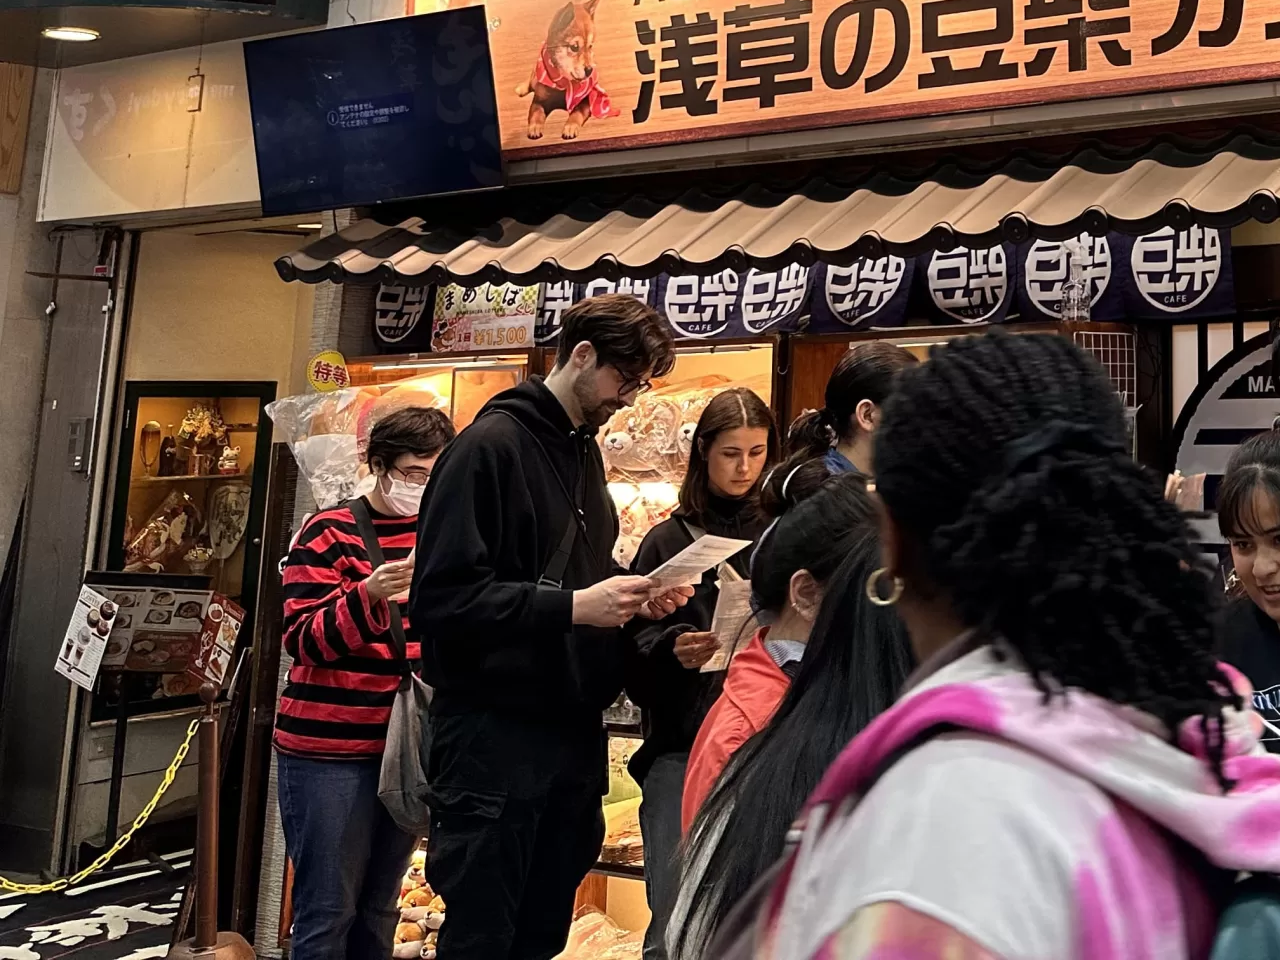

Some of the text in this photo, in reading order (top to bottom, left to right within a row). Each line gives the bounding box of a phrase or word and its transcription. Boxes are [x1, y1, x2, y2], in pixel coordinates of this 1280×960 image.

[444, 284, 524, 311] まめしば
[1163, 294, 1187, 304] CAFE
[473, 326, 527, 346] ¥1,500
[688, 323, 712, 332] CAFE
[314, 360, 348, 386] 特等
